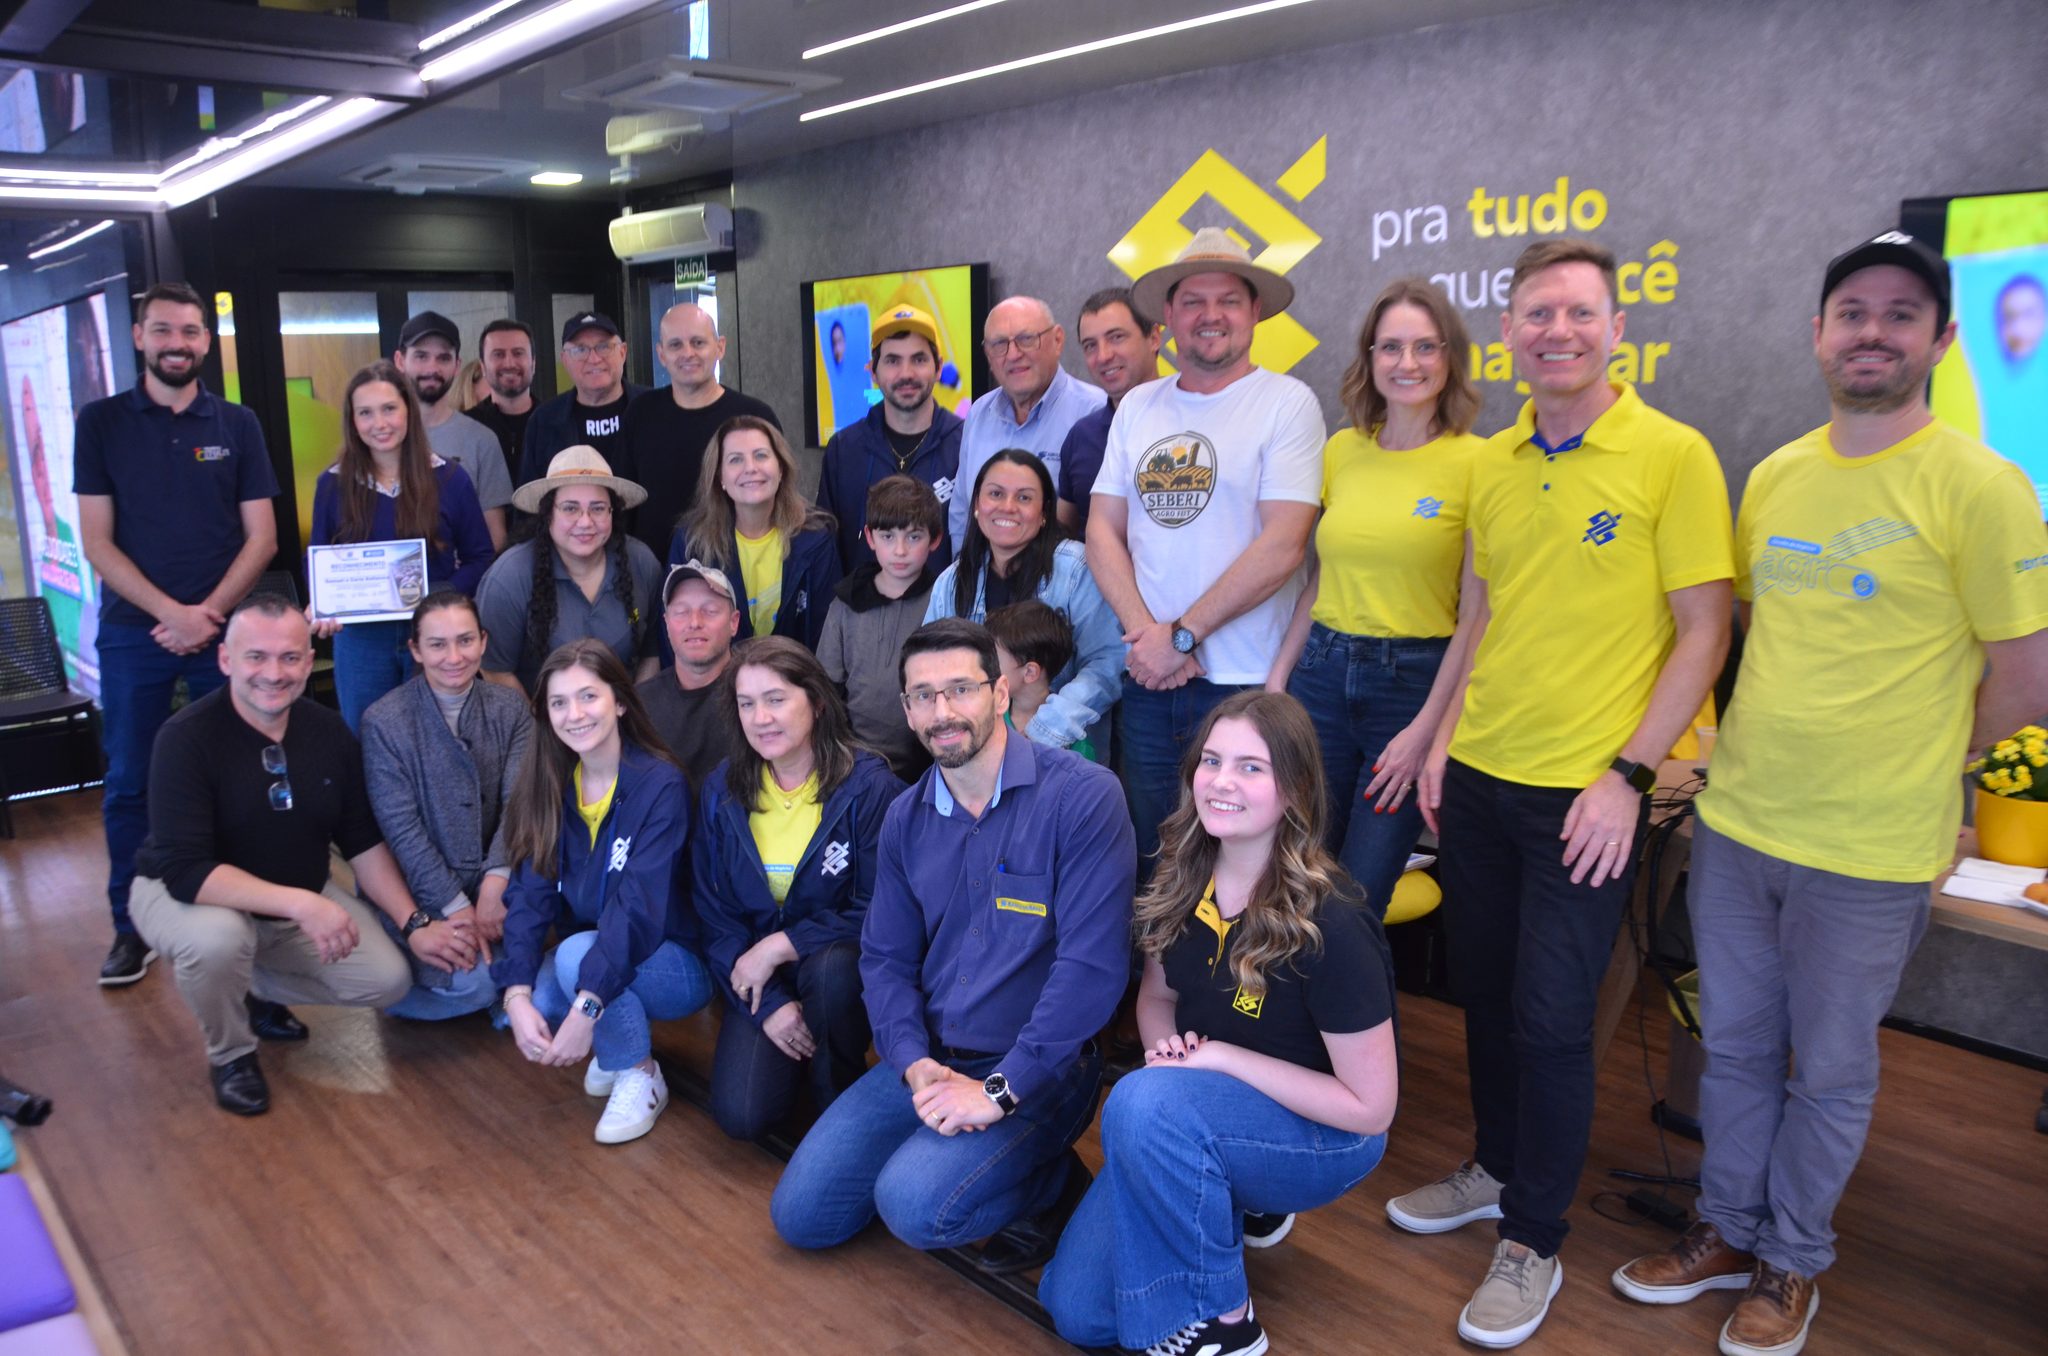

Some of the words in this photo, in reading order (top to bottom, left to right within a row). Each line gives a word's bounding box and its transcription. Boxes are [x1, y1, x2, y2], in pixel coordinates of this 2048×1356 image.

[1372, 204, 1449, 261] pra
[1466, 176, 1608, 238] tudo
[677, 258, 705, 281] SAÍDA
[1616, 238, 1680, 305] cê
[585, 415, 620, 437] RICH
[1147, 492, 1201, 508] SEBERI
